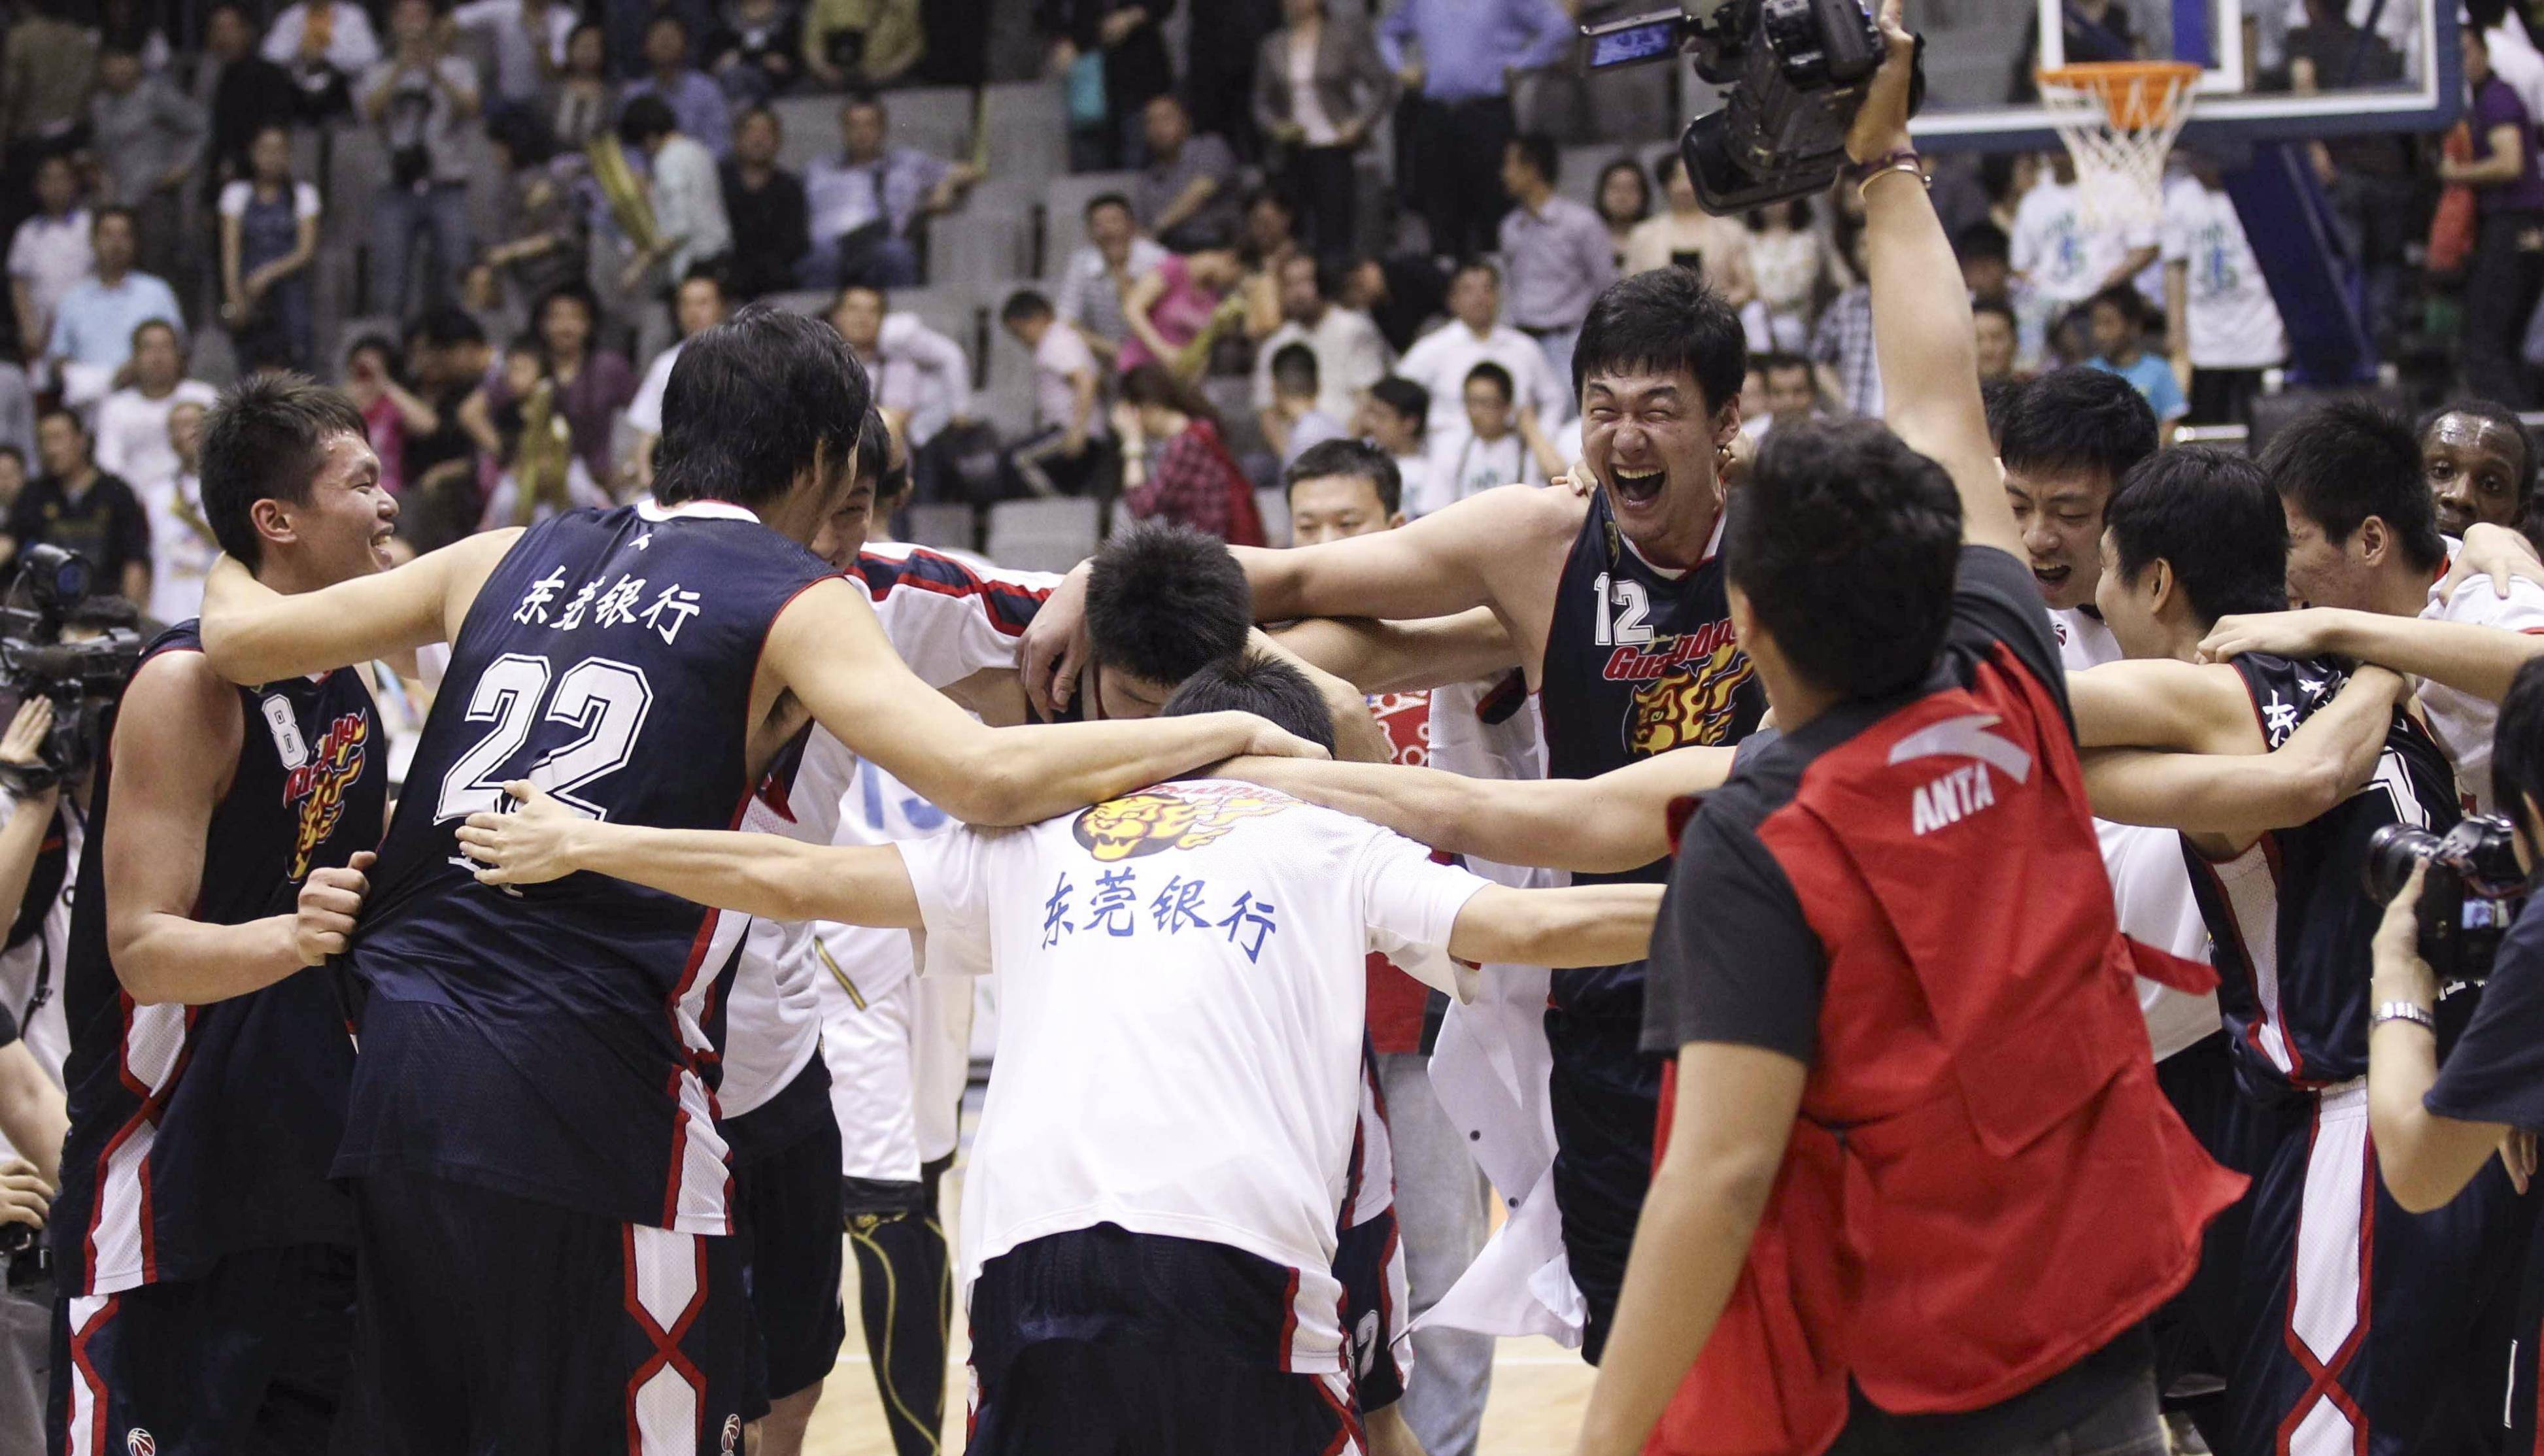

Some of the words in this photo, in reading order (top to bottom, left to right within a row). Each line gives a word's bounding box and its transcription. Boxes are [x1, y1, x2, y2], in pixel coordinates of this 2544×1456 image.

[513, 565, 700, 645] 东莞银行
[1594, 572, 1654, 645] 12
[262, 694, 307, 770] 8
[433, 653, 653, 825] 22
[1913, 762, 1995, 835] ANTA
[1042, 866, 1276, 964] 东莞银行
